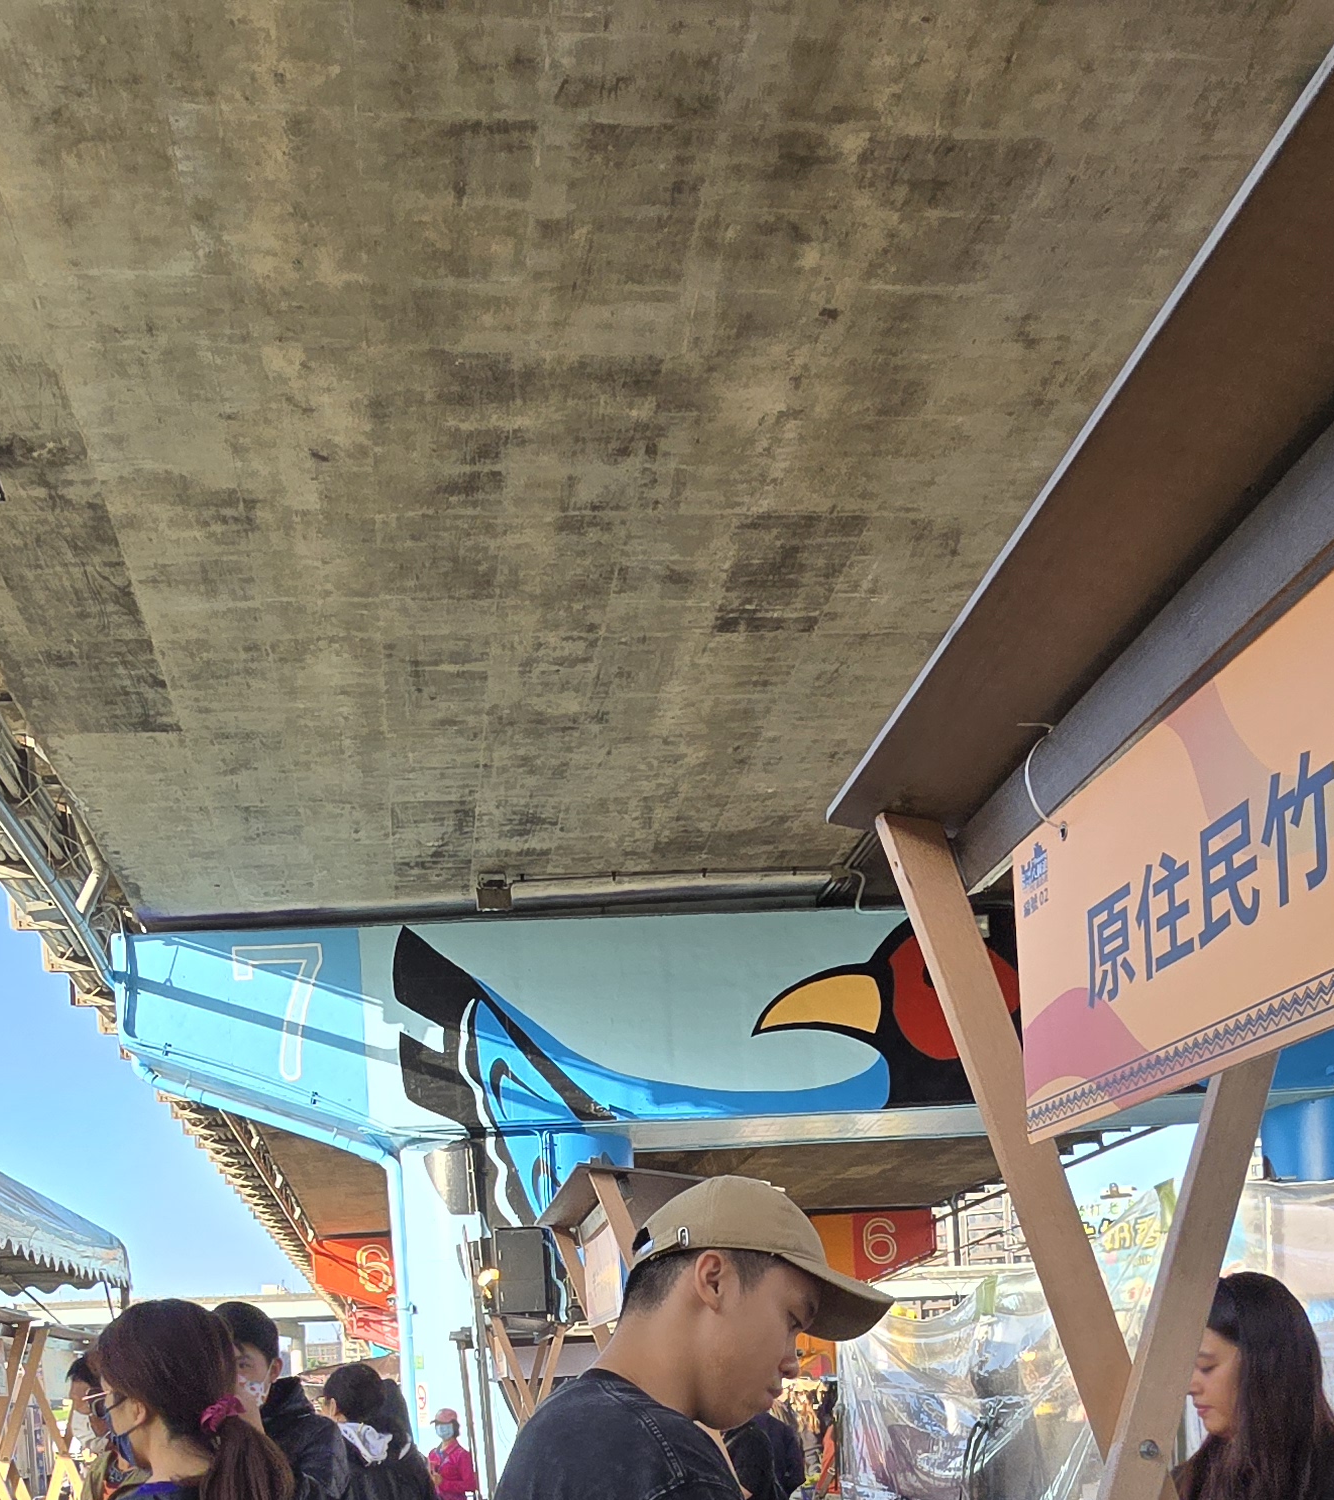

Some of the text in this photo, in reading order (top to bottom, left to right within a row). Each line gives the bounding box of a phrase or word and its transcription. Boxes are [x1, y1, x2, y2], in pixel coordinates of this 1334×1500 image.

[232, 942, 323, 1081] 7
[863, 1217, 897, 1264] 6
[355, 1244, 393, 1293] 6
